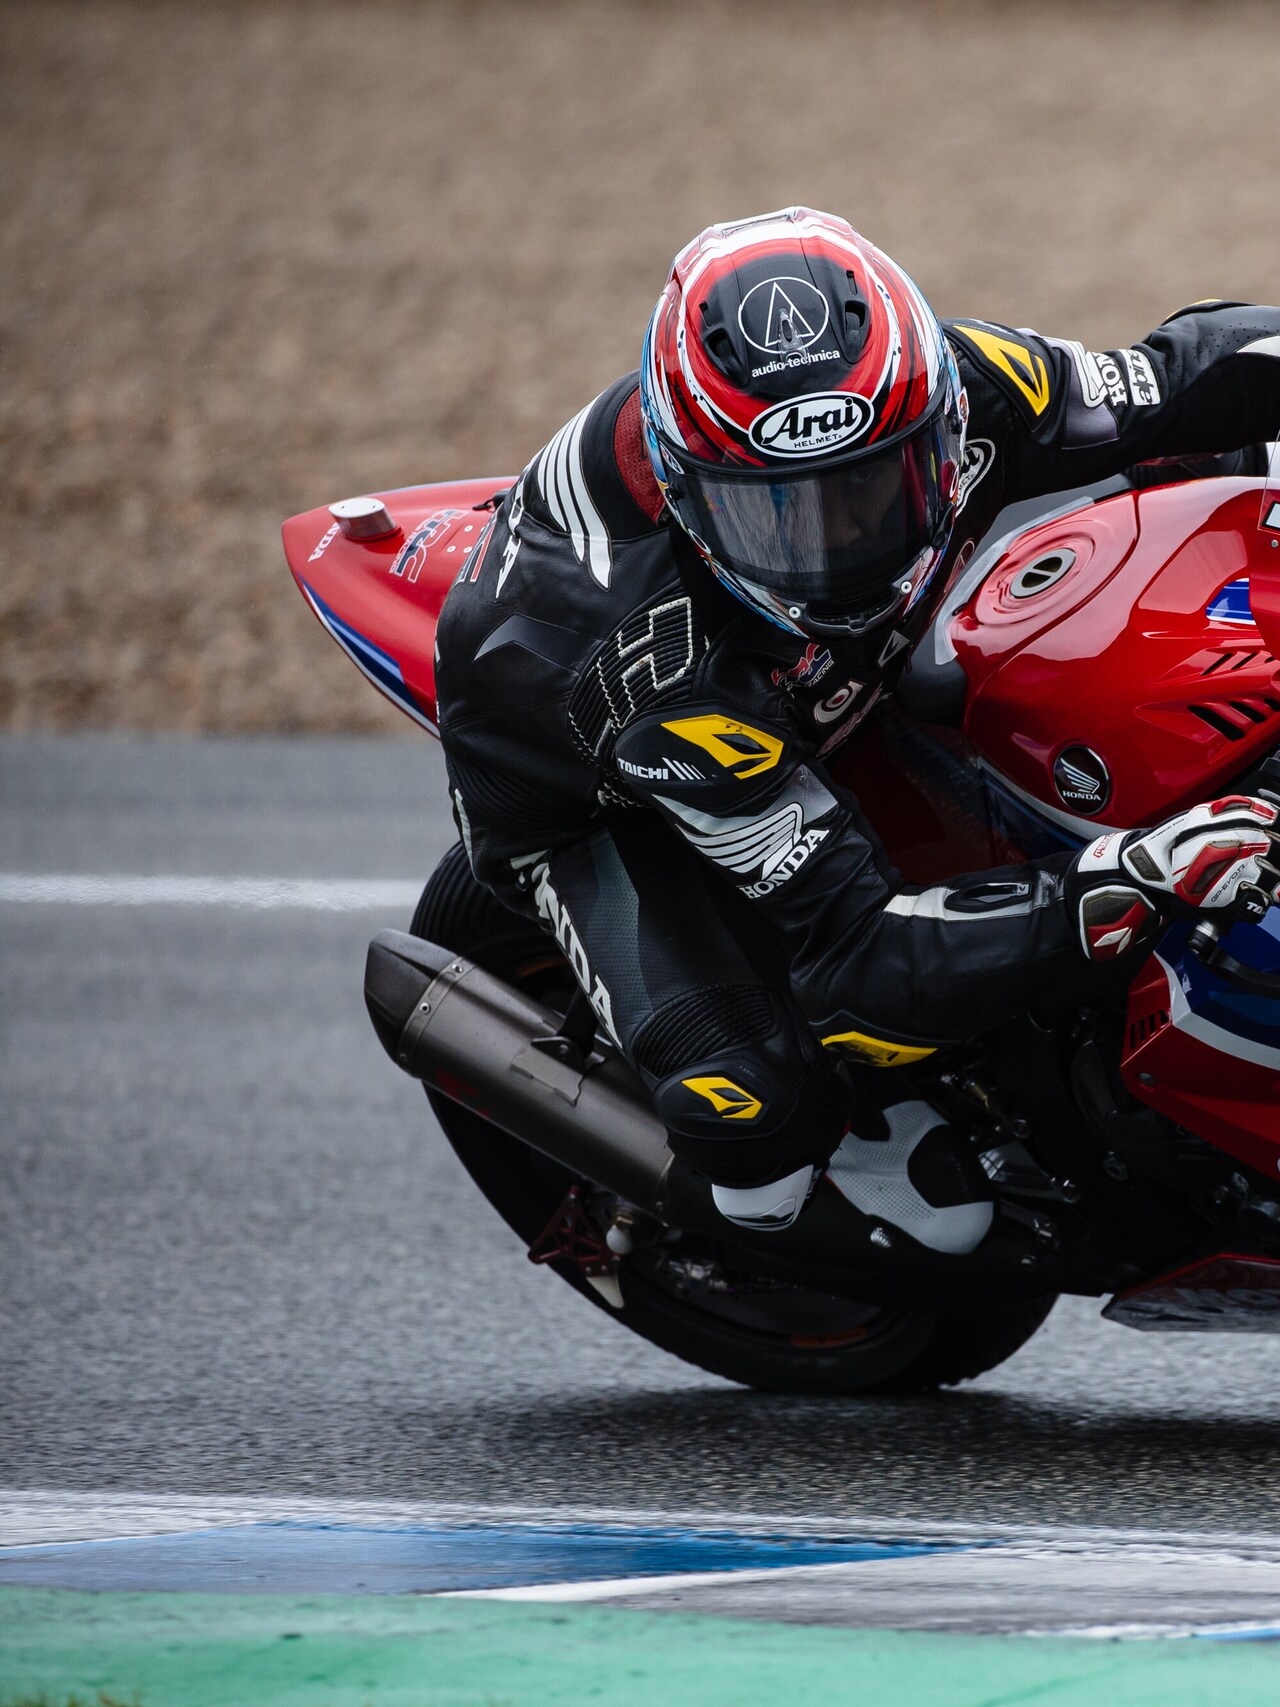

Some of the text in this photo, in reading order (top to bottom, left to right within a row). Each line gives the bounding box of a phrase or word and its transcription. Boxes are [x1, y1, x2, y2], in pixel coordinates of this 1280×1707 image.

[752, 350, 840, 378] audio-technica
[1093, 352, 1128, 407] HON
[761, 397, 859, 445] Arai
[794, 433, 839, 448] HELMET
[308, 522, 341, 562] NDA
[617, 757, 669, 780] TAICHI
[1063, 790, 1101, 801] HONDA
[738, 827, 830, 899] HONDA
